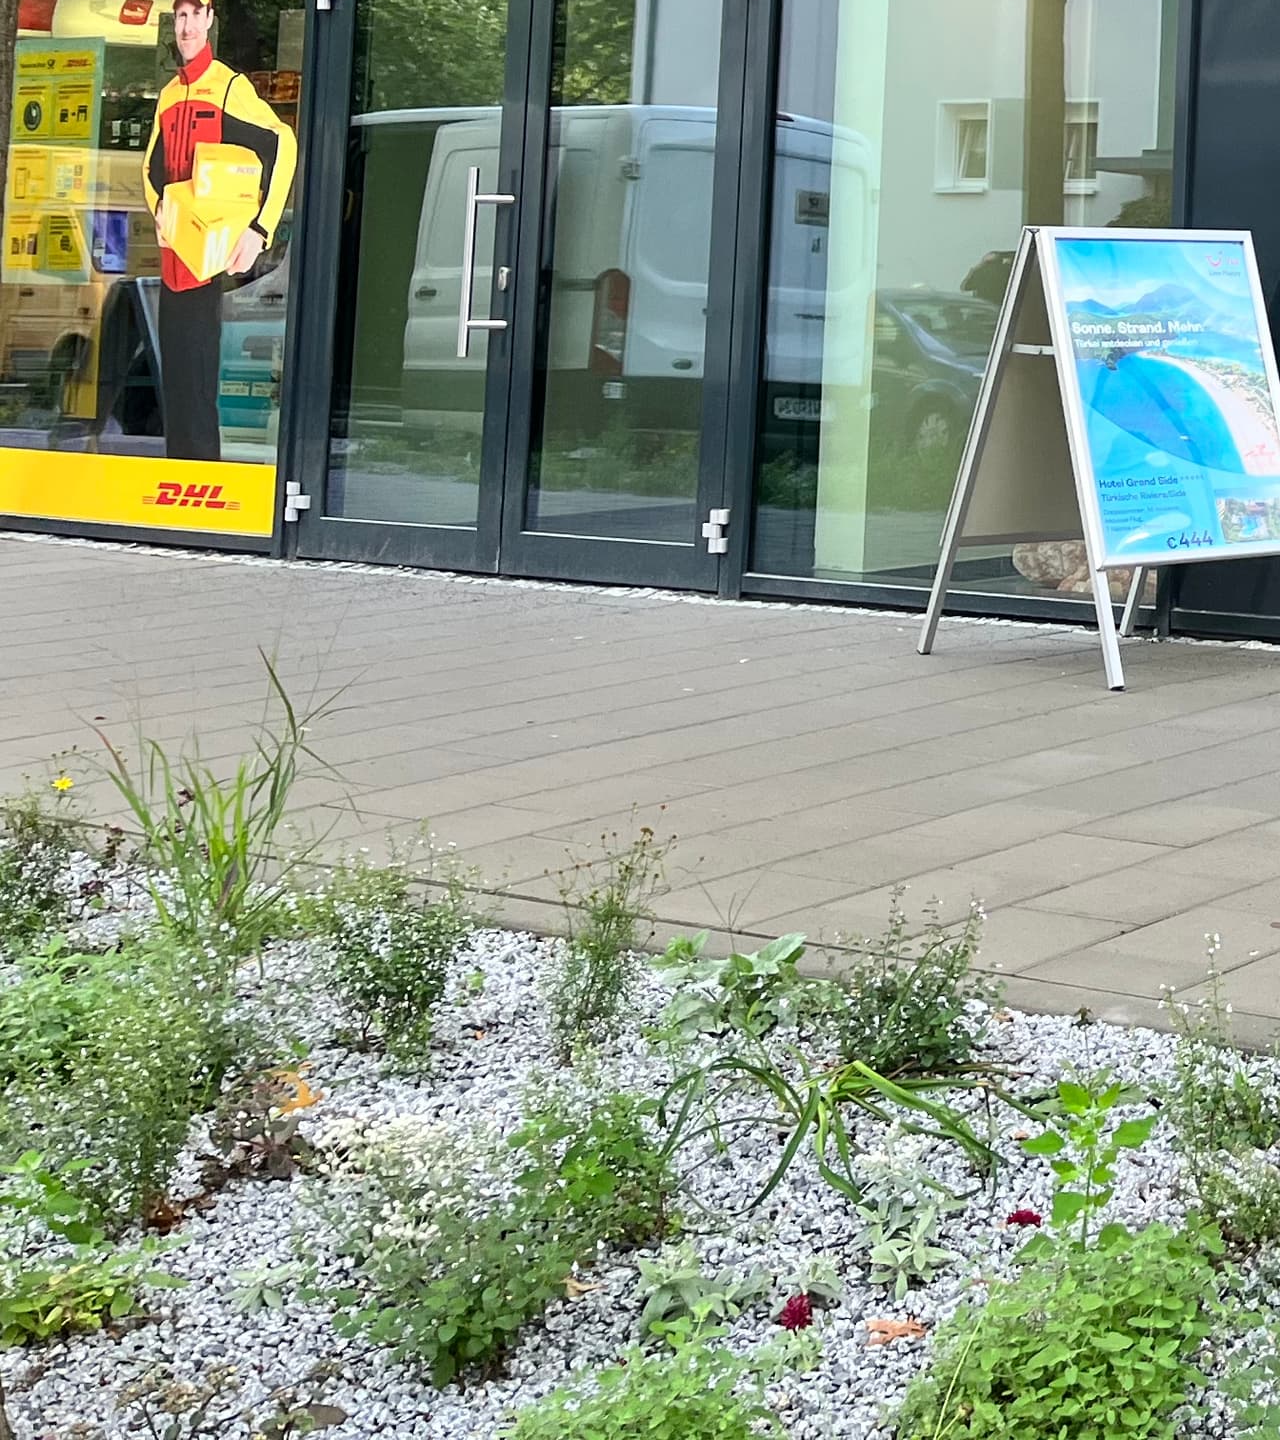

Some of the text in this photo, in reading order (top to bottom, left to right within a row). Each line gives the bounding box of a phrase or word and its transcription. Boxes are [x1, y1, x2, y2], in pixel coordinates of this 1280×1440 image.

[1072, 320, 1204, 334] Sonne. Strand. Mehr.
[1099, 479, 1124, 489] Hotel
[1126, 476, 1156, 487] Grand
[155, 482, 226, 509] DHL
